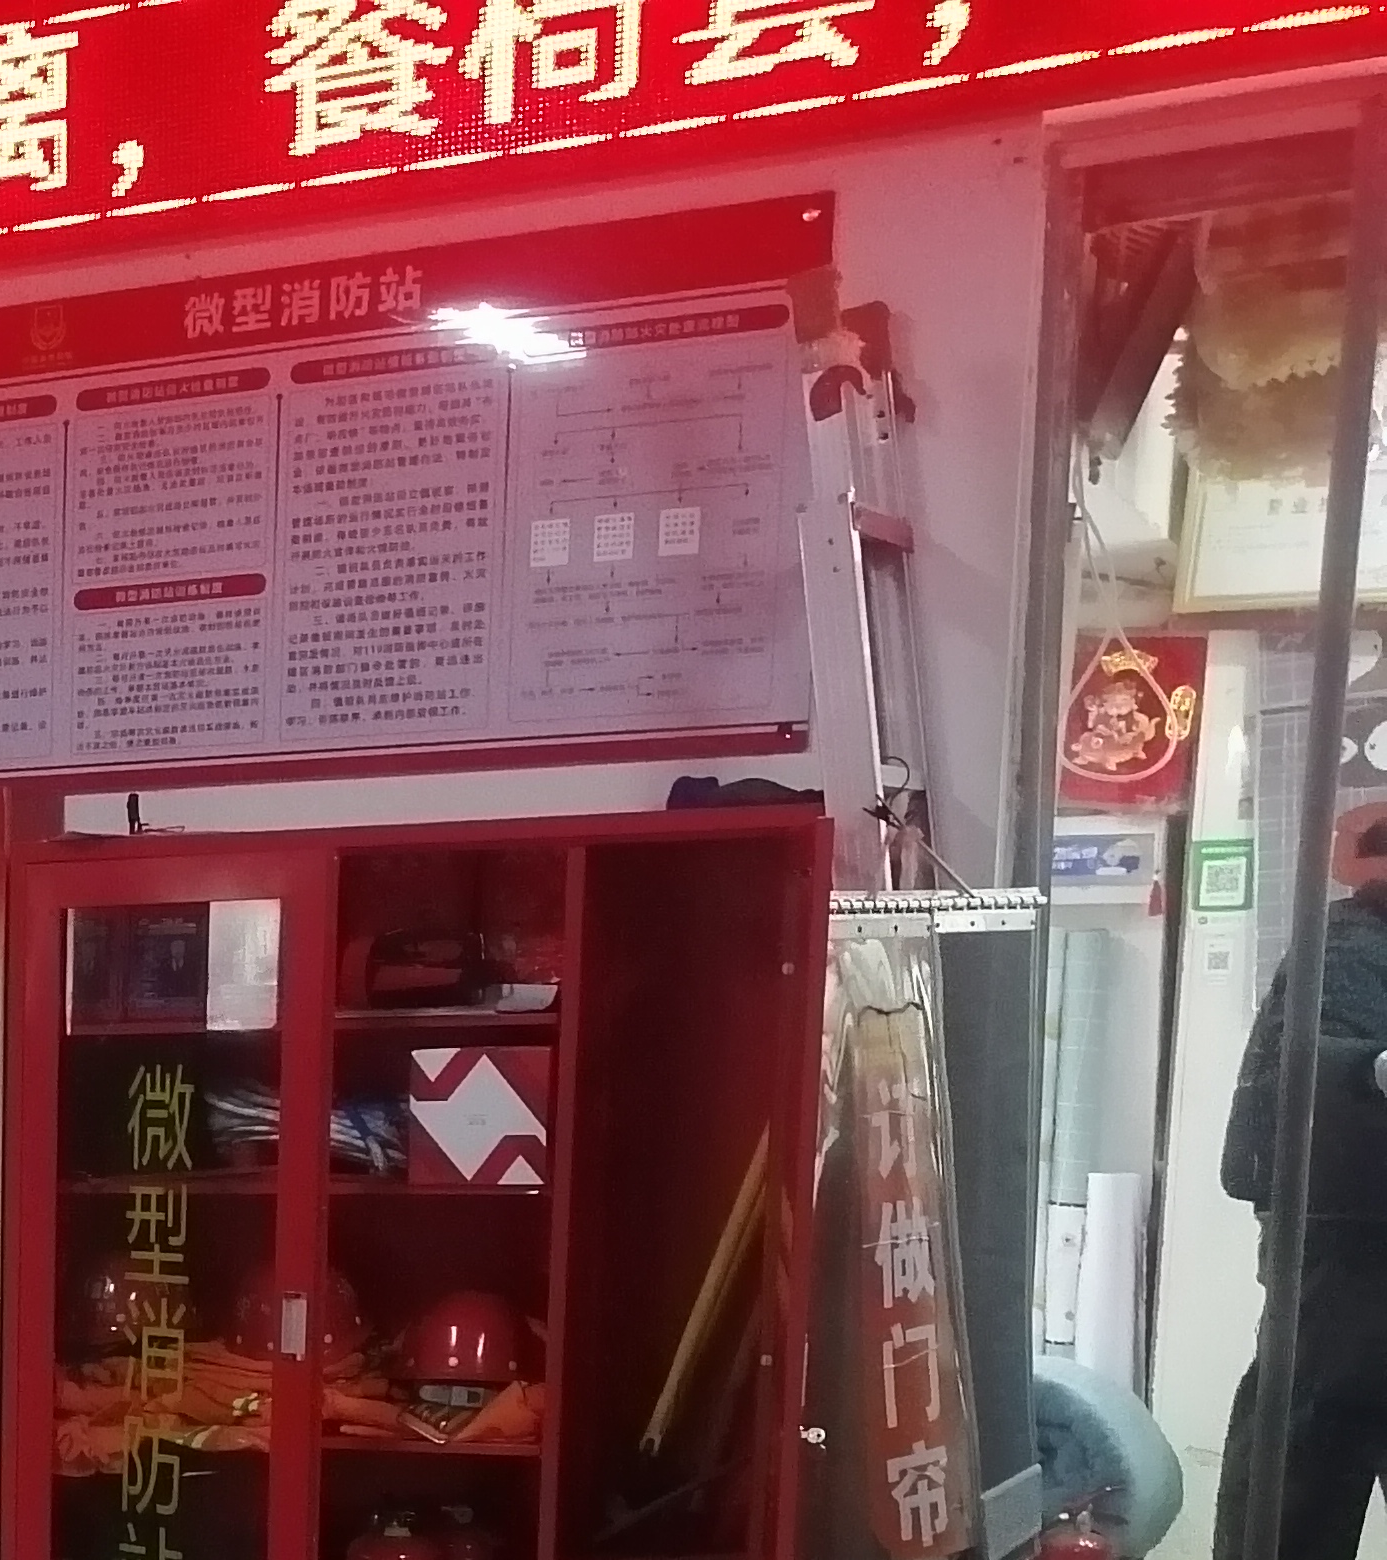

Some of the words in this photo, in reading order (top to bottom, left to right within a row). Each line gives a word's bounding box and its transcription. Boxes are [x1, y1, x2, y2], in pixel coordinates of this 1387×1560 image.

[183, 264, 424, 339] 微型消防站
[870, 1078, 949, 1547] 订做门帘
